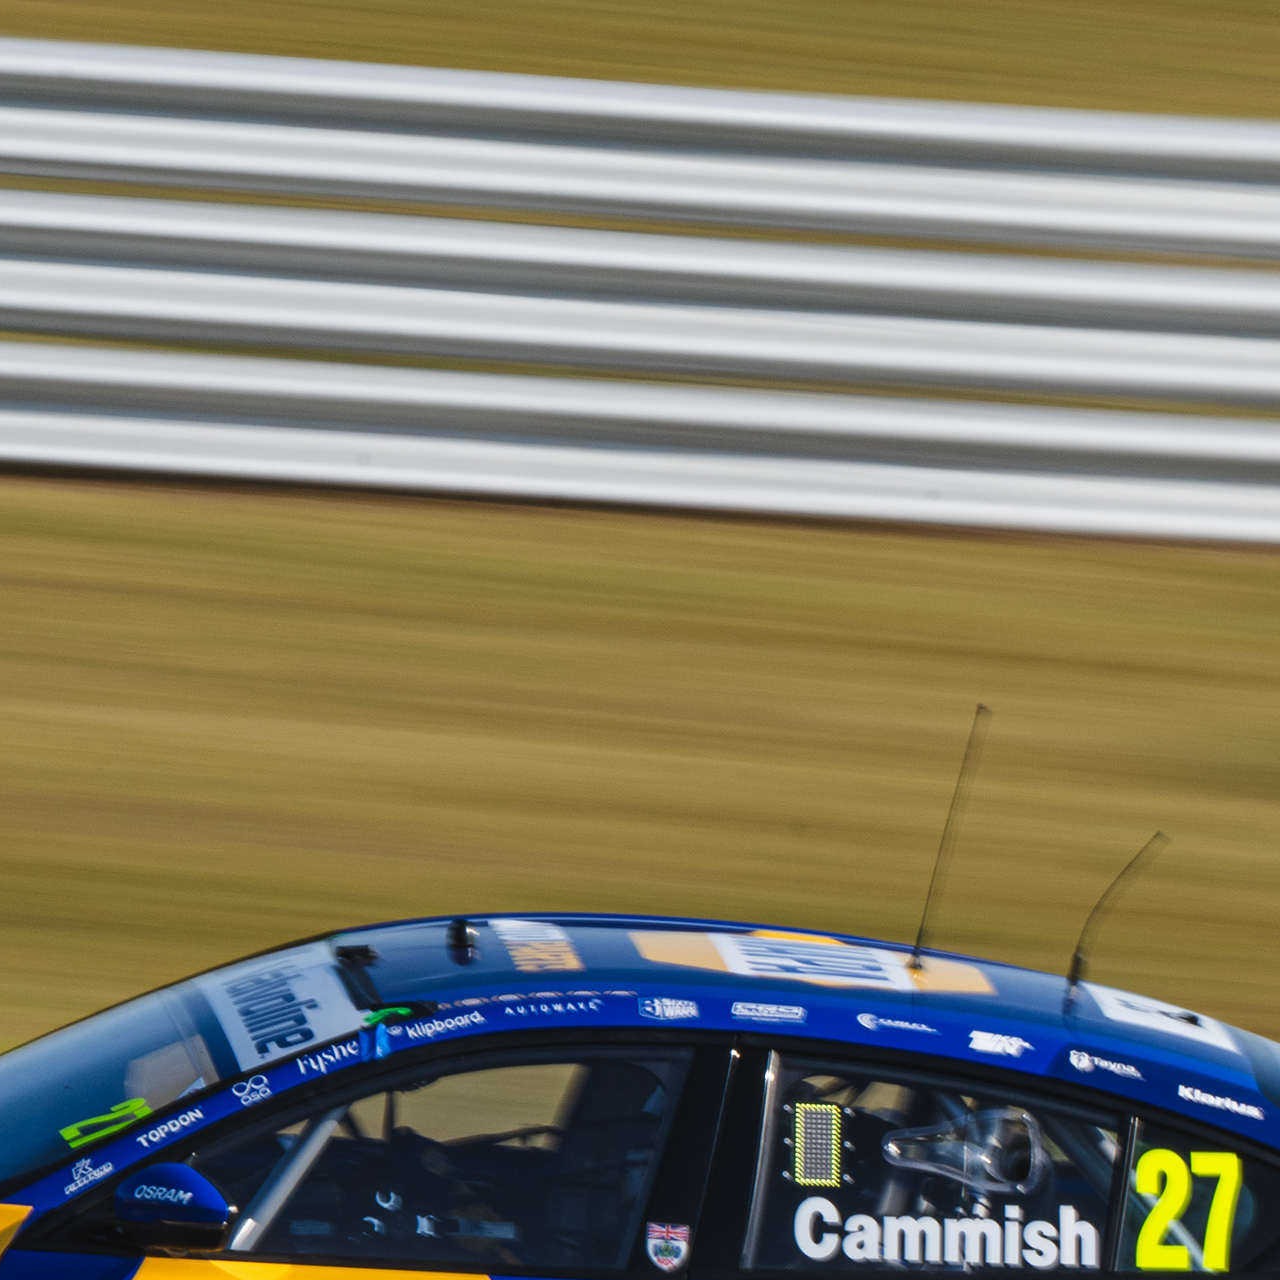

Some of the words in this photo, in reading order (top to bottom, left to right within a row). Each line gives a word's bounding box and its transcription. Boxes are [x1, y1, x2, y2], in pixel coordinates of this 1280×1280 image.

[1177, 1084, 1266, 1121] Klarius
[136, 1106, 205, 1148] TOPDON
[134, 1184, 194, 1206] OSRAM
[1135, 1147, 1244, 1273] 27
[793, 1196, 1102, 1271] Cammish
